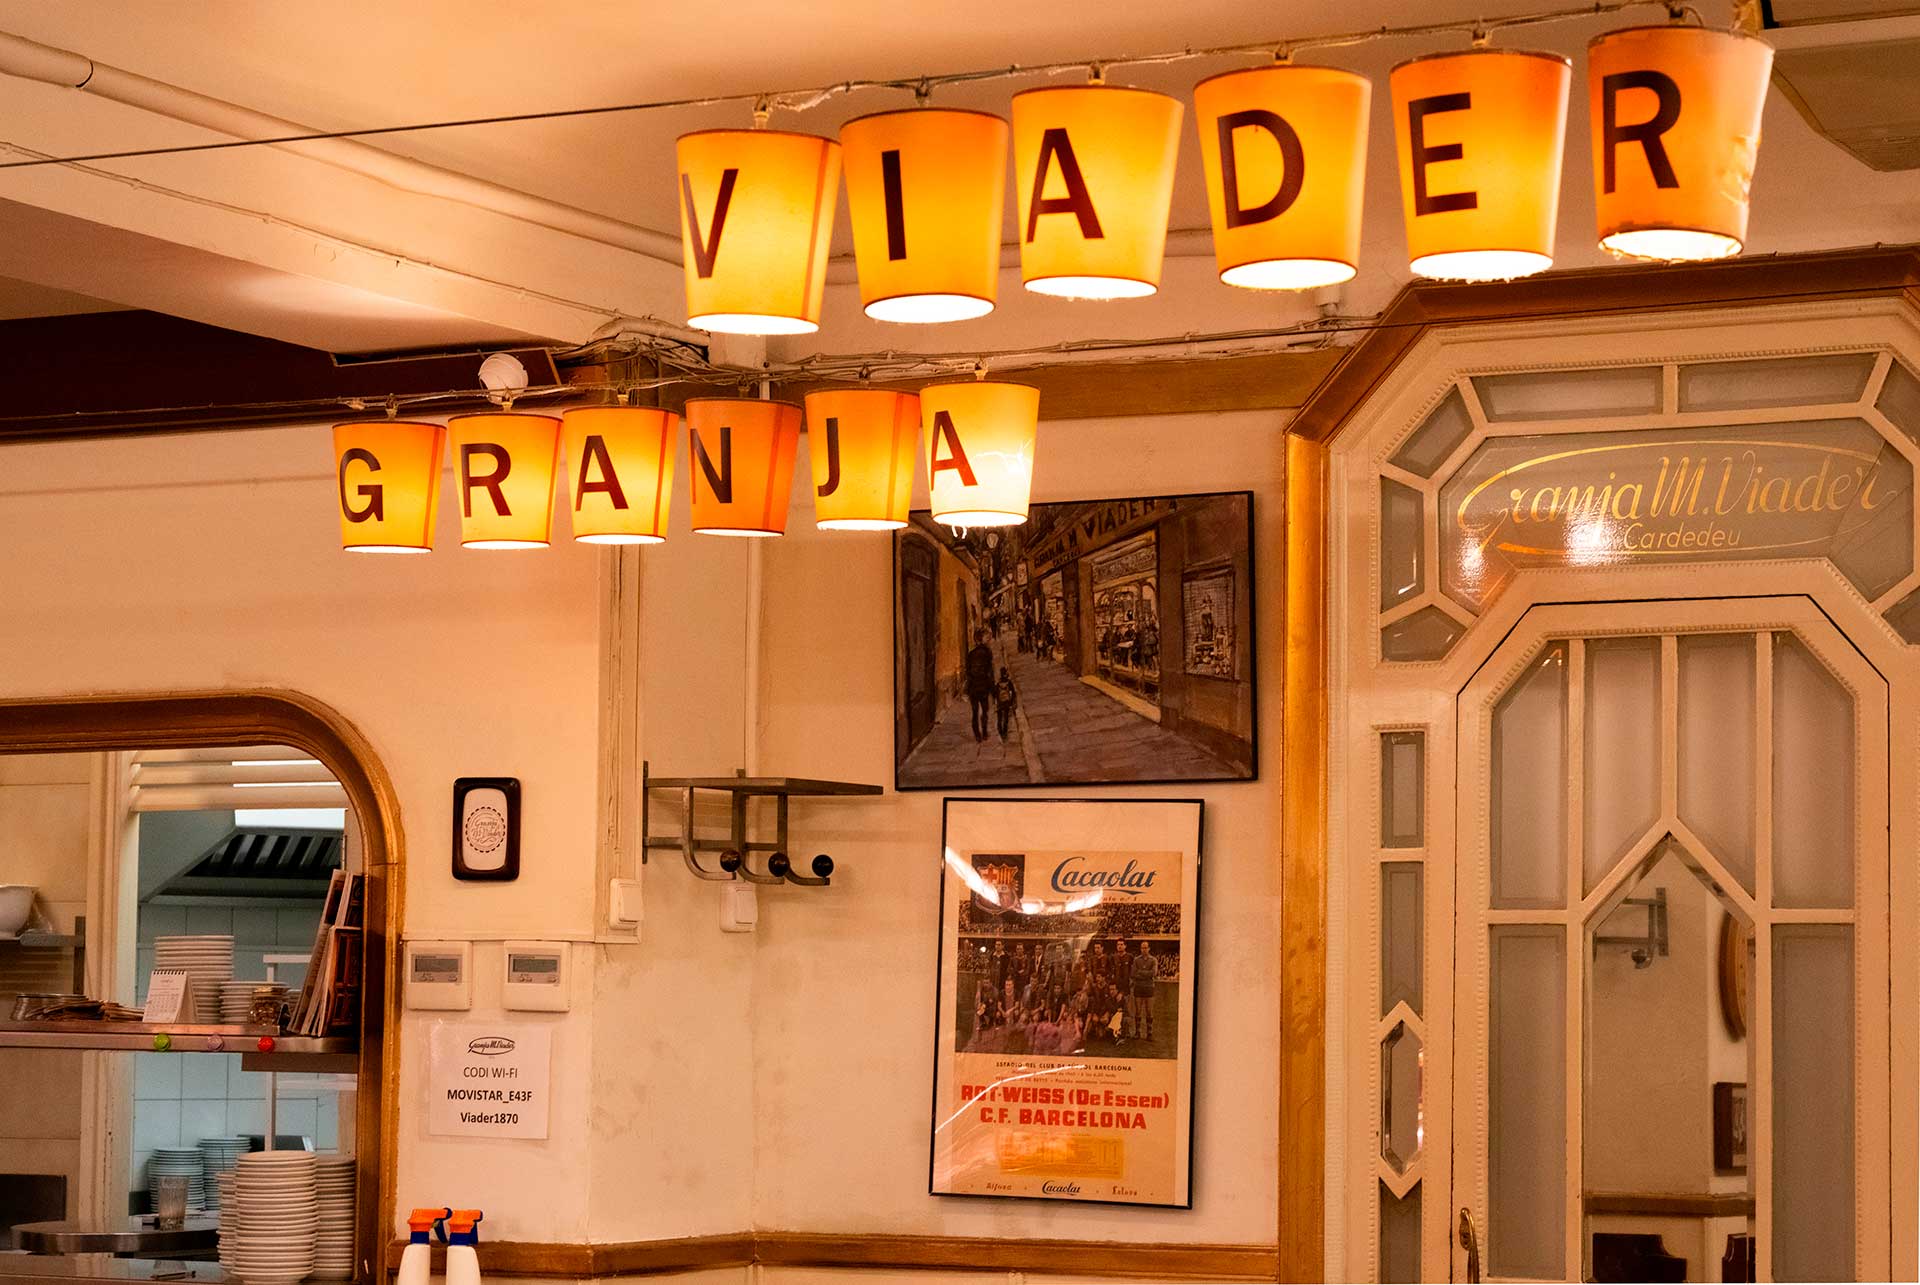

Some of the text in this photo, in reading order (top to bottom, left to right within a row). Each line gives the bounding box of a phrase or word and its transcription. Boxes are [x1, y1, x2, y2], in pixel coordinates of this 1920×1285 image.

[681, 69, 1683, 279] VIADER
[338, 409, 979, 523] GRANJA
[1457, 468, 1643, 546] Granja
[1717, 450, 1894, 515] Viader
[1623, 521, 1741, 551] Cardedeu
[1051, 856, 1157, 895] Cacaolat
[463, 1066, 518, 1079] CODI WI-FI
[1094, 1064, 1132, 1072] BARCELONA
[447, 1089, 533, 1104] MOVISTAR_E43F
[460, 1111, 519, 1124] Viader1870
[980, 1107, 1147, 1130] C.F. BARCELONA
